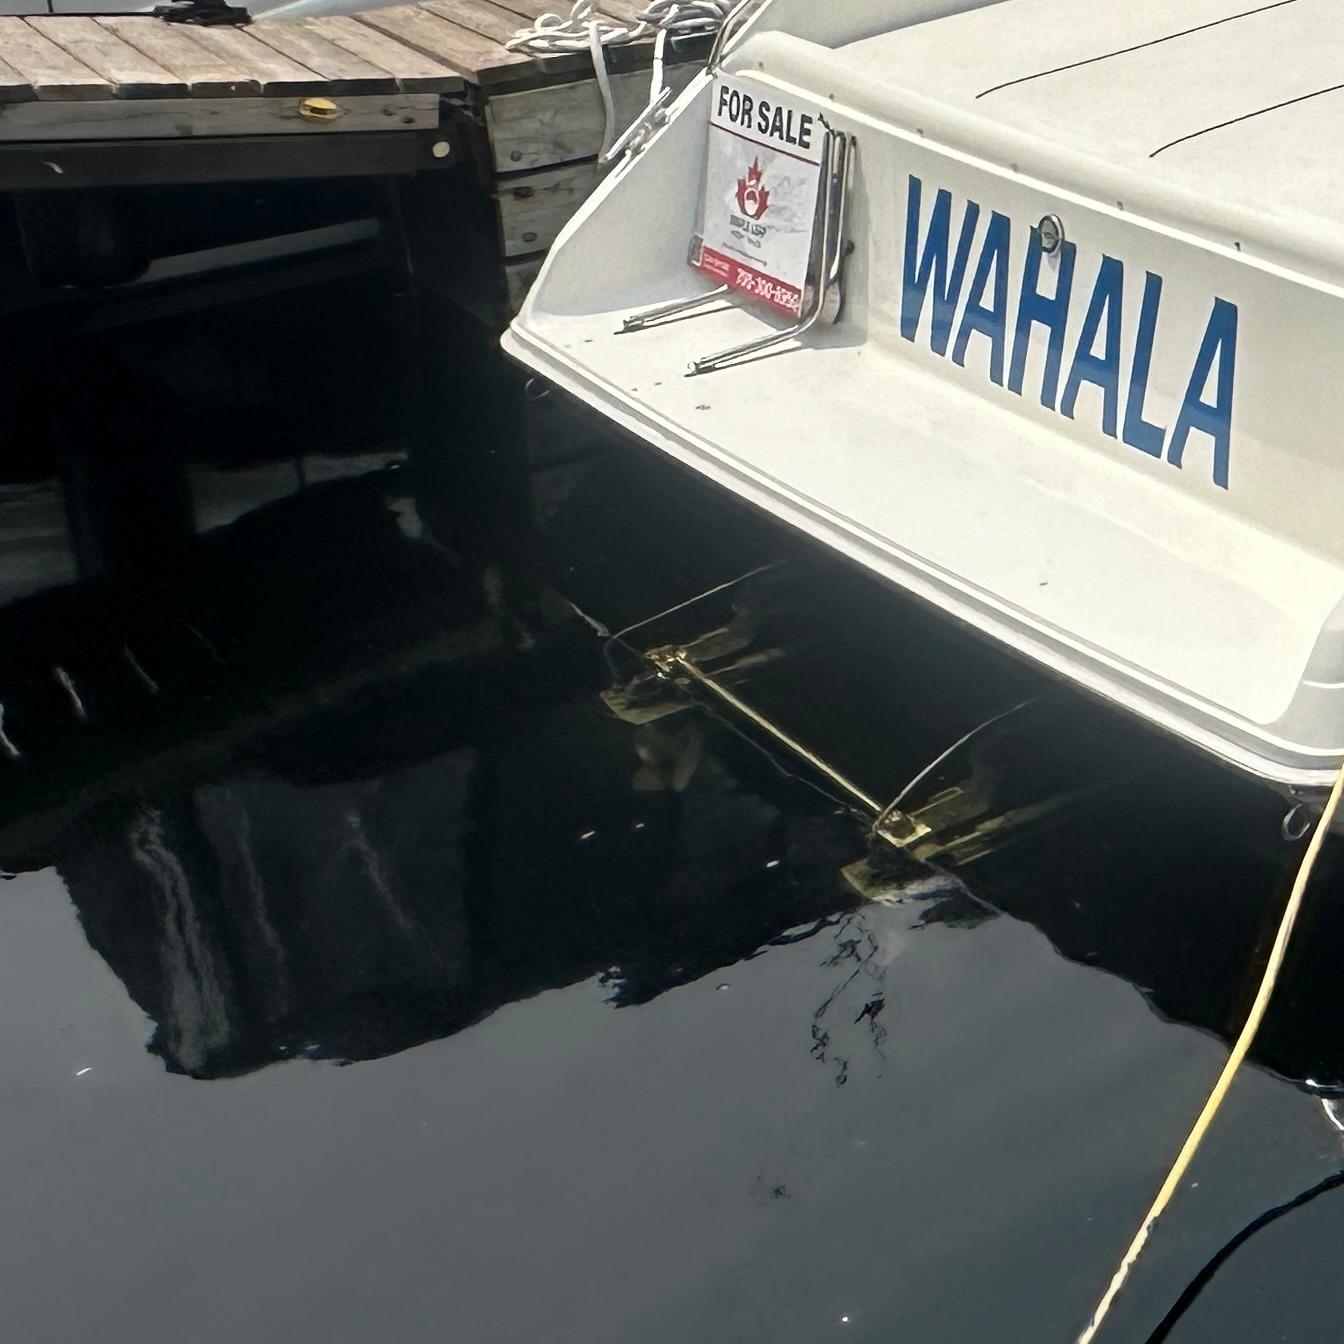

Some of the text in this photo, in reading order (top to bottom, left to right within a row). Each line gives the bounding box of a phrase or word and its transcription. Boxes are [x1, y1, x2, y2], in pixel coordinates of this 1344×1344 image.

[717, 85, 814, 149] FOR SALE
[899, 173, 1240, 491] WAHALA
